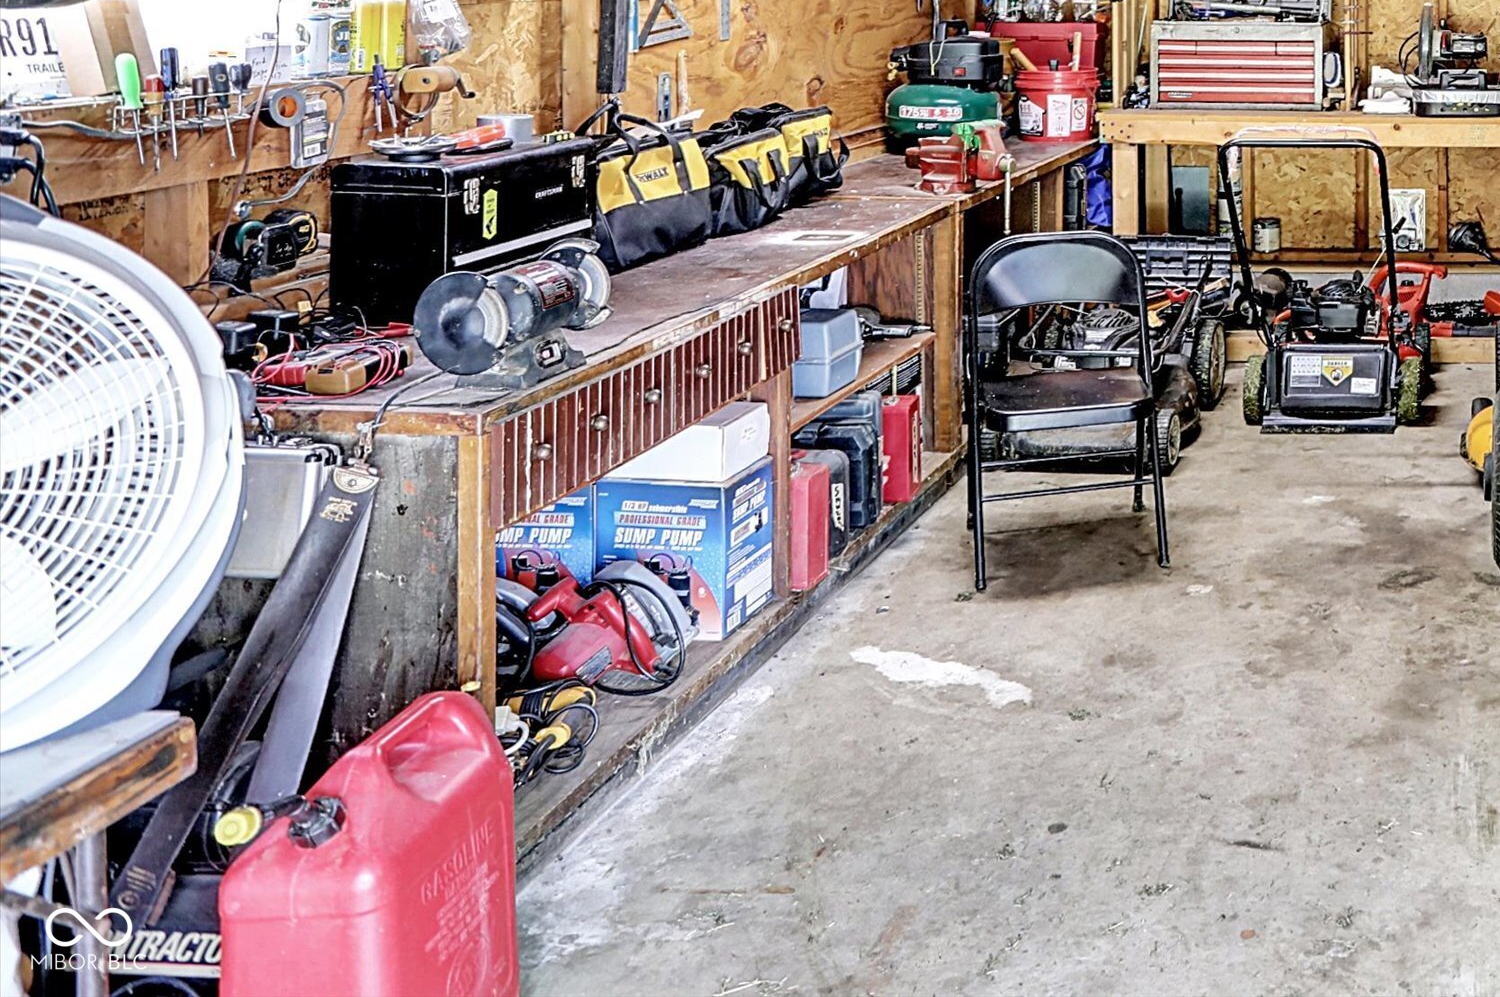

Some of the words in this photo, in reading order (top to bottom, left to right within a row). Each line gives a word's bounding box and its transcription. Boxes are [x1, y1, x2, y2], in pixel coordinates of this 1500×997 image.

[27, 61, 65, 73] TRAILE
[535, 184, 564, 199] CRAFTSMAN
[543, 513, 570, 525] GRADE
[619, 514, 673, 525] PROFESSIONAL
[676, 517, 701, 526] GRADE
[496, 528, 523, 544] UMP
[529, 527, 573, 544] PUMP
[614, 527, 656, 545] SUMP
[660, 529, 704, 546] PUMP
[421, 818, 495, 905] GASOLINE
